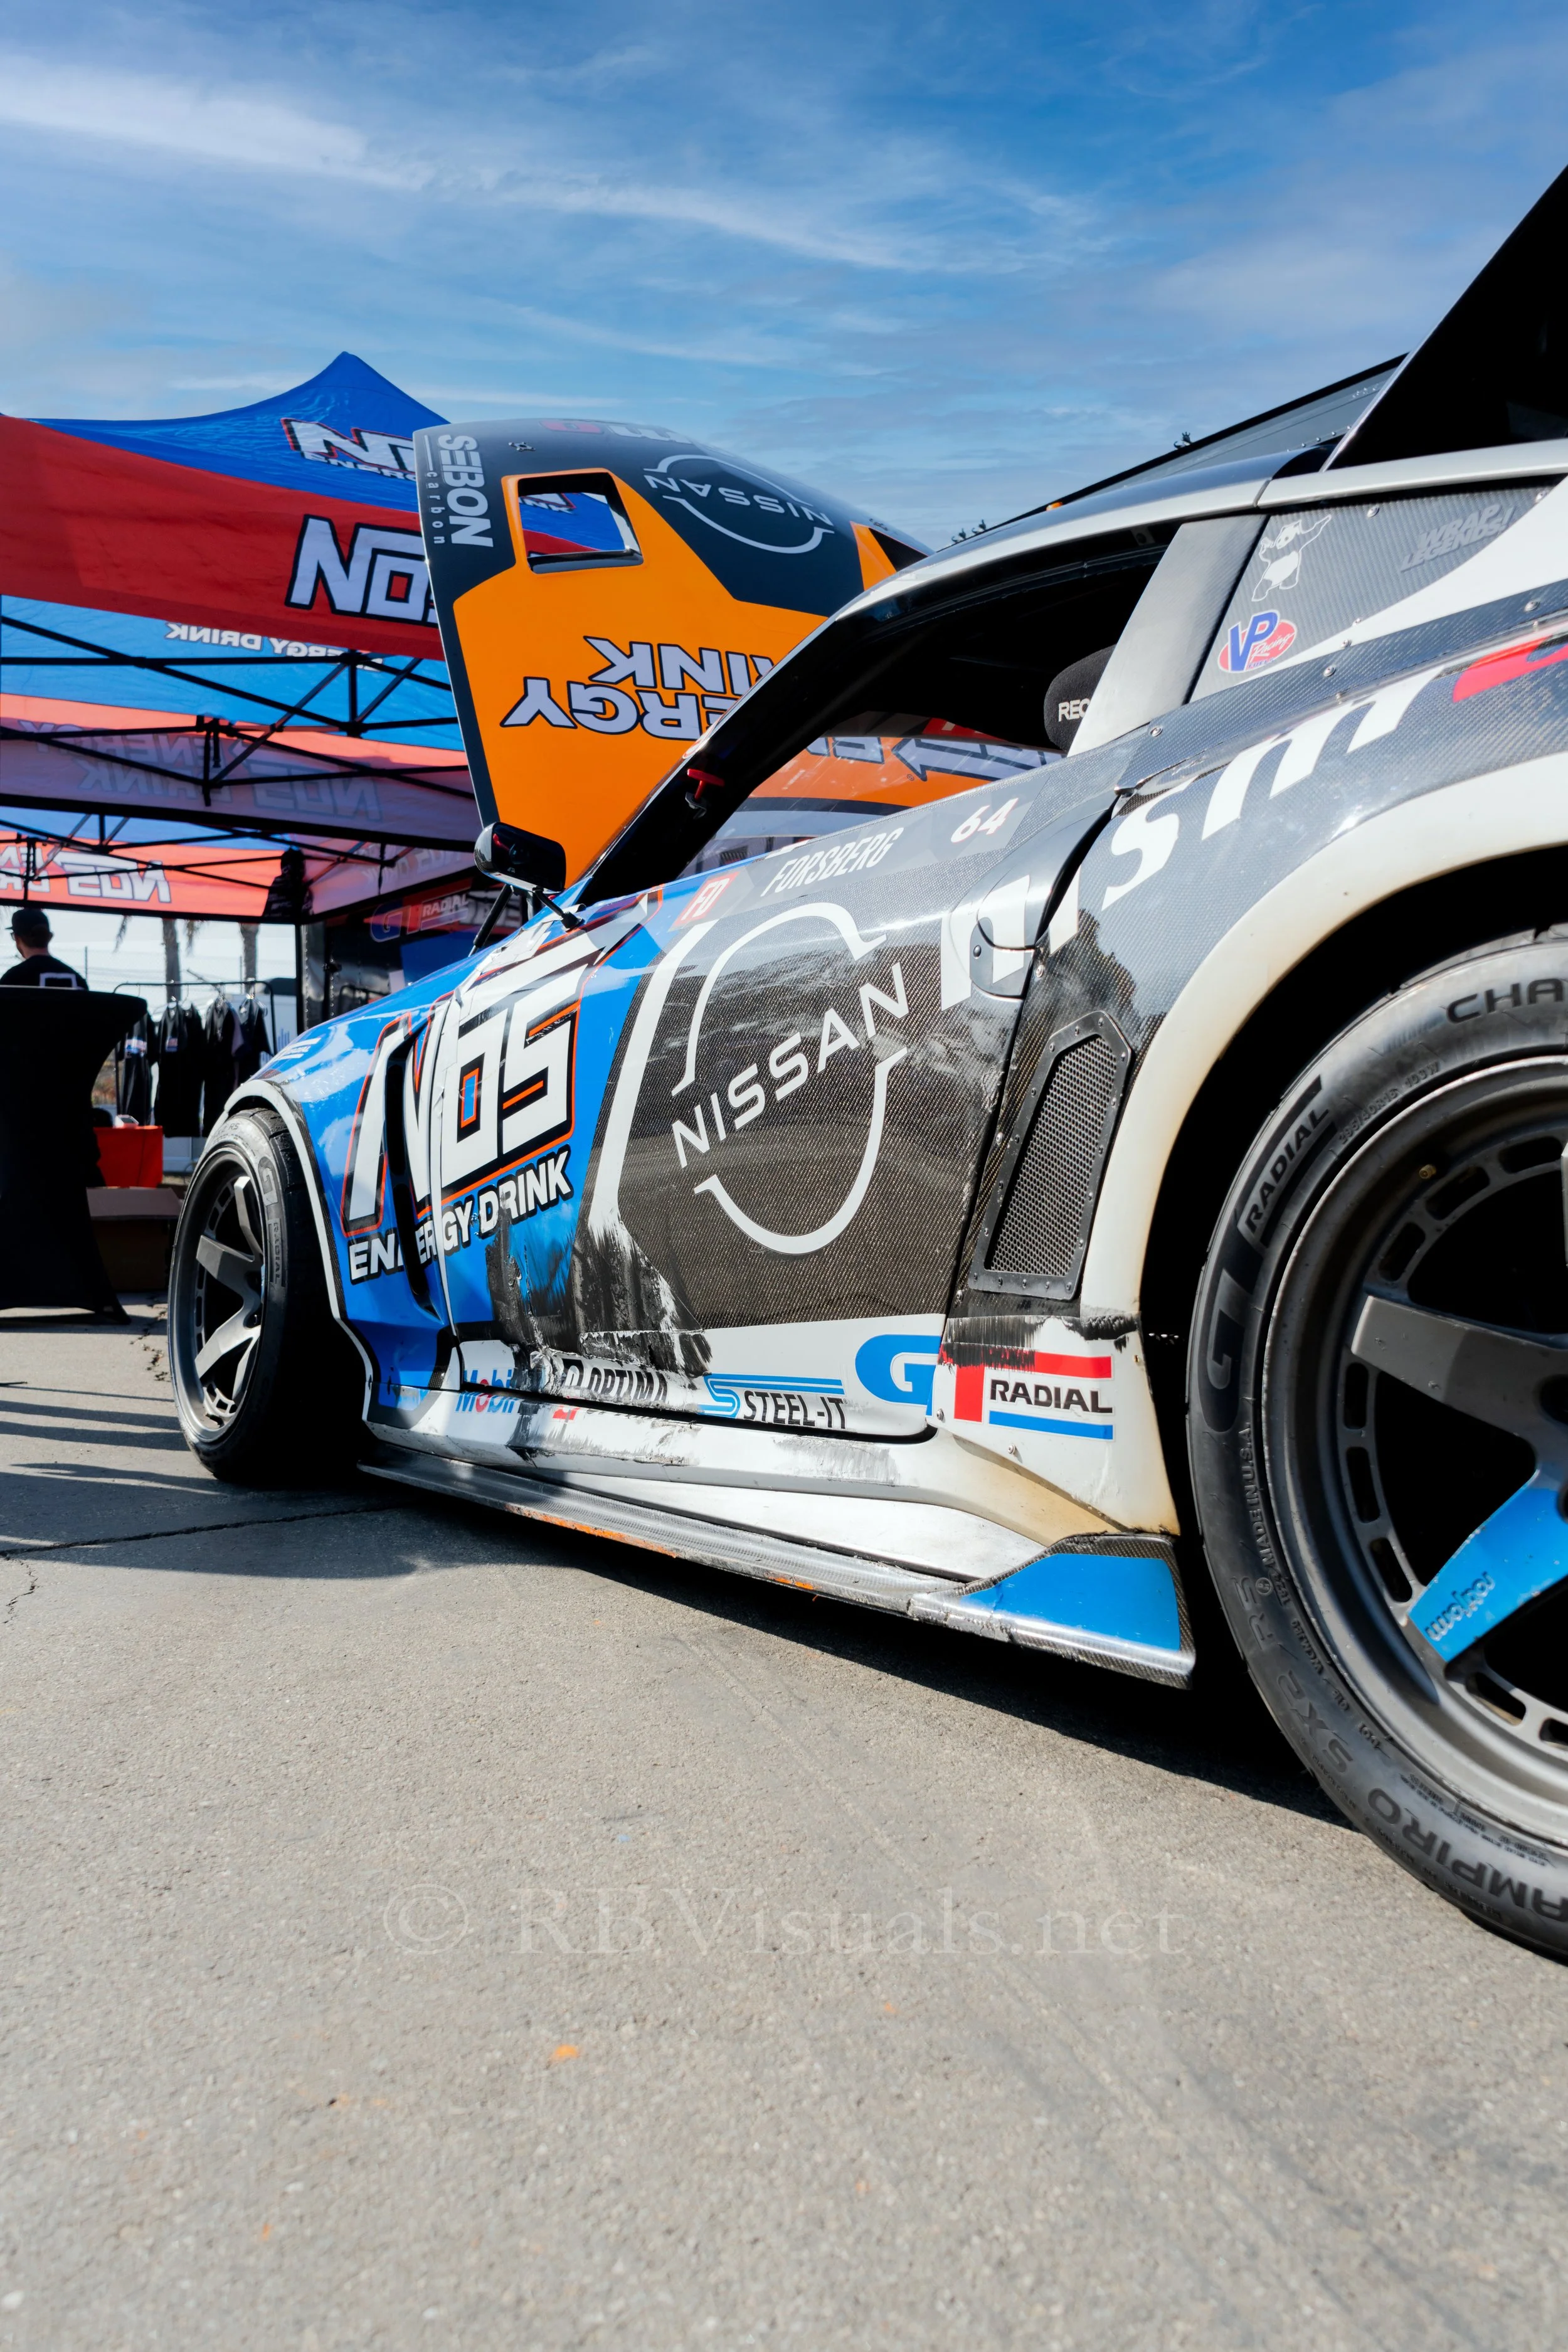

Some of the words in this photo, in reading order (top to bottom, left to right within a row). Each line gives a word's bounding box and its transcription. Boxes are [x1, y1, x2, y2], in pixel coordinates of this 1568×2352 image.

[426, 472, 445, 544] carbon
[438, 434, 494, 547] SEIBON
[644, 475, 833, 526] NISSAN
[1419, 504, 1503, 549] WRAP
[284, 514, 443, 628] NO
[1229, 610, 1279, 672] VP
[1251, 633, 1295, 662] Racing
[950, 798, 1019, 844] 64
[760, 827, 904, 898] FORSBERG
[422, 893, 469, 918] RADIAL
[679, 876, 733, 922] FD
[344, 903, 652, 1234] NOS
[672, 962, 909, 1168] NISSAN
[1244, 1106, 1330, 1233] RADIAL
[348, 1199, 477, 1283] ENERGY
[478, 1148, 573, 1239] DRINK
[270, 1220, 283, 1286] RADIAL
[586, 1365, 671, 1405] OPTIMA
[854, 1333, 1112, 1424] GT
[989, 1379, 1114, 1414] RADIAL
[1243, 1476, 1259, 1500] IN
[1249, 1501, 1276, 1567] MADE
